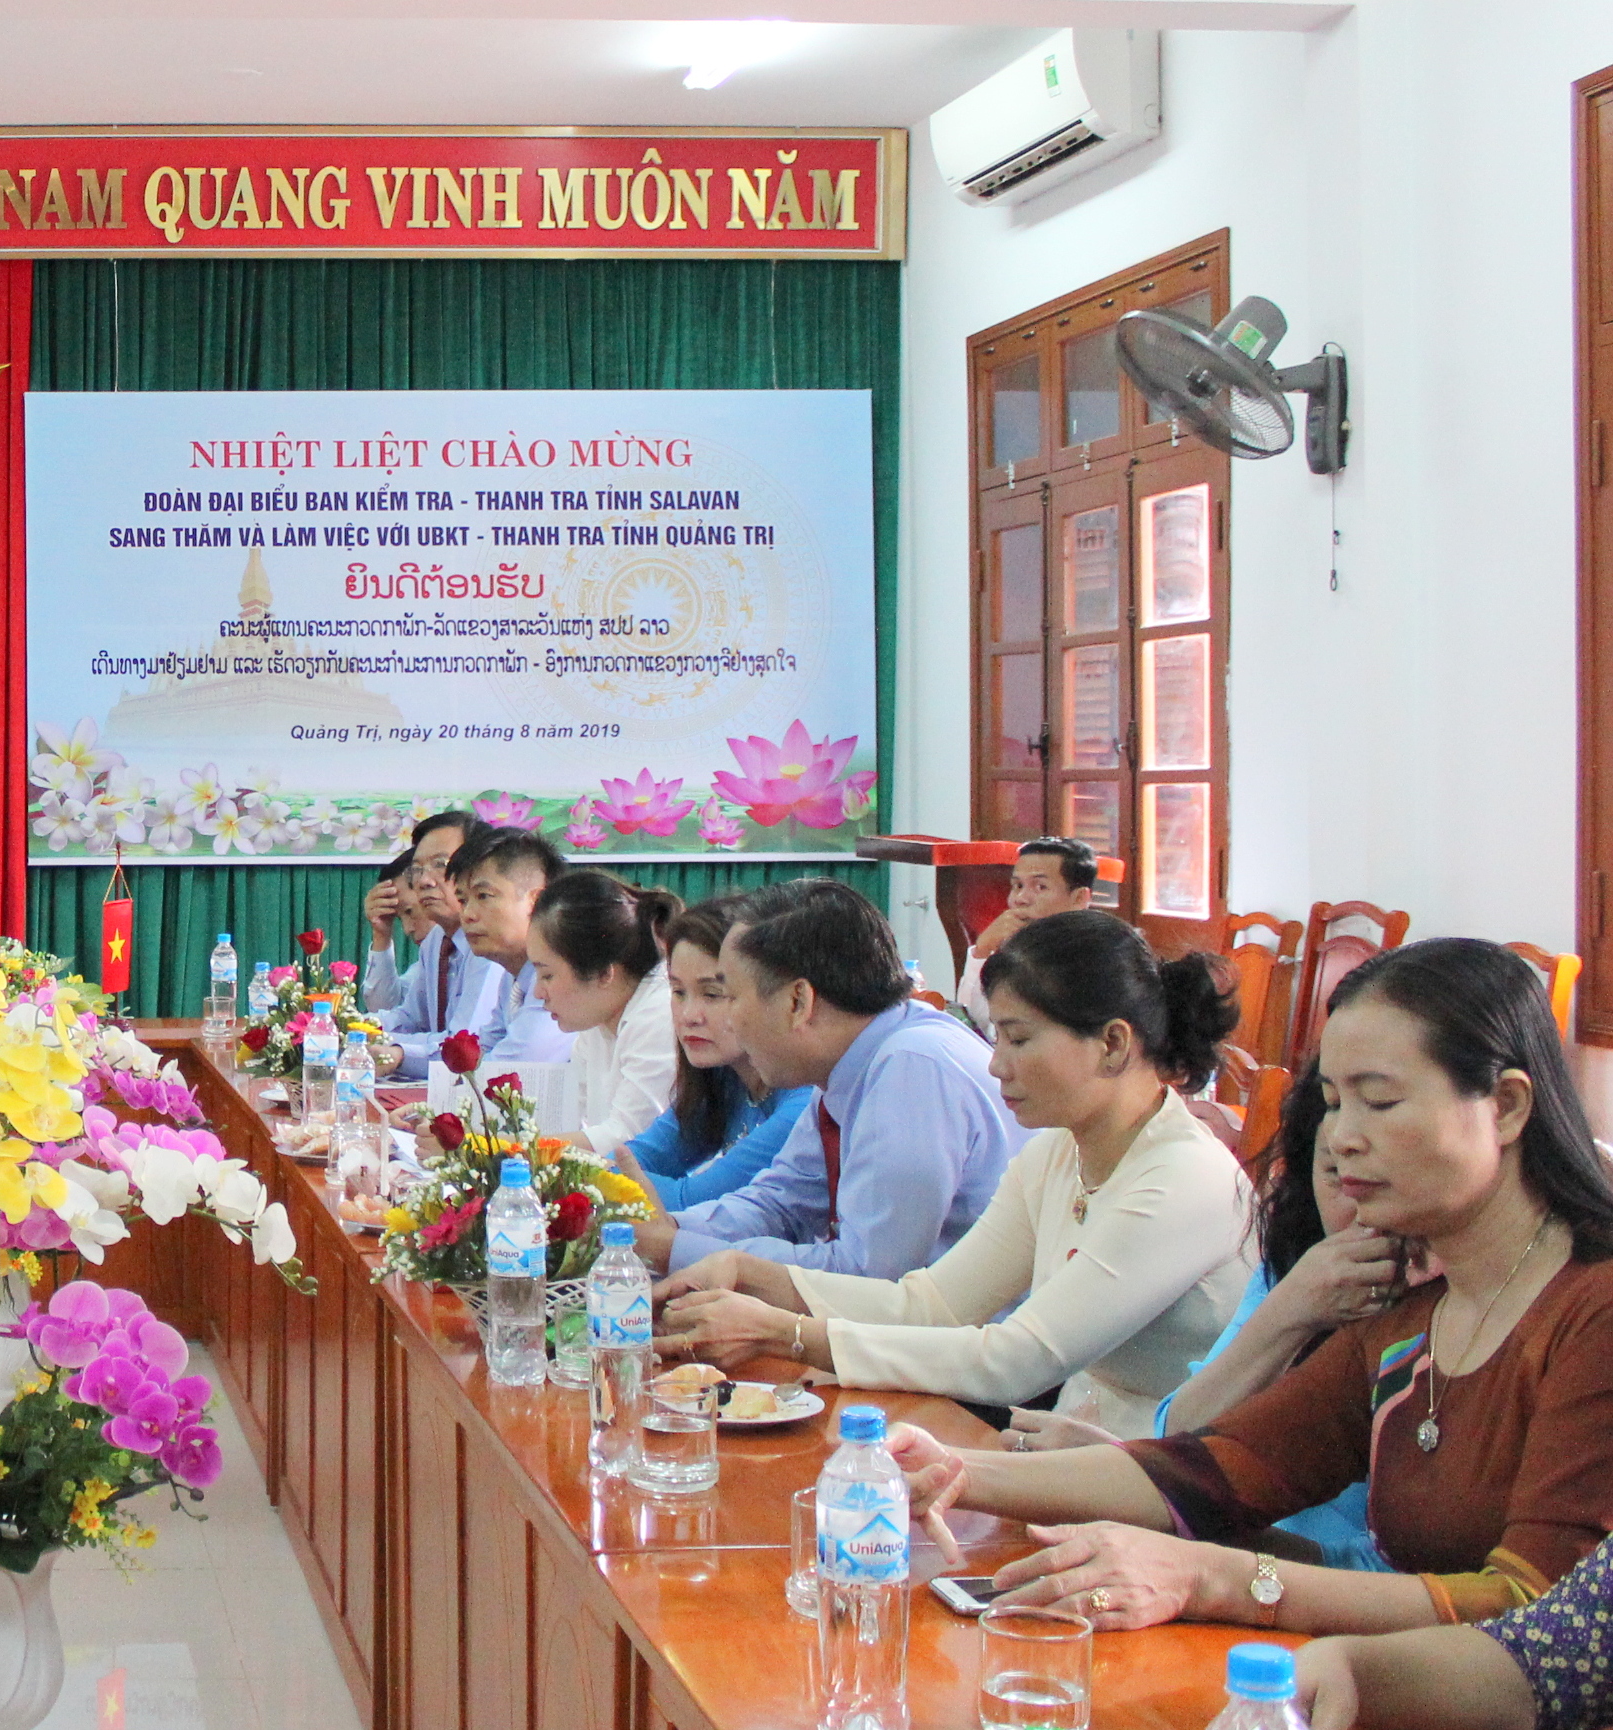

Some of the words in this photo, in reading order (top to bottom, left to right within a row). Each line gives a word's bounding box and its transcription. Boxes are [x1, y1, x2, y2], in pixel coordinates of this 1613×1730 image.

[143, 165, 351, 243] QUANG
[365, 165, 523, 230] VINH
[537, 148, 714, 231] MUÔN
[725, 149, 861, 231] NĂM
[189, 431, 321, 476] NHIỆT
[333, 430, 428, 476] LIỆT
[441, 430, 556, 468] CHÀO
[569, 429, 693, 468] MỪNG
[144, 487, 202, 512] ĐOÀN
[208, 491, 243, 517] ĐẠI
[250, 483, 298, 511] BIỂU
[305, 491, 348, 511] BAN
[355, 483, 408, 511] KIỂM
[415, 491, 454, 511] TRA
[475, 490, 543, 511] THANH
[550, 490, 589, 511] TRA
[595, 484, 642, 511] TỈNH
[649, 490, 740, 511] SALAVAN
[109, 527, 166, 548] SANG
[172, 523, 232, 548] THĂM
[238, 522, 266, 547] VÀ
[272, 522, 317, 547] LÀM
[323, 522, 370, 551] VIỆC
[376, 522, 410, 547] VỚI
[417, 526, 470, 547] UBKT
[491, 526, 560, 546] THANH
[566, 526, 605, 546] TRA
[611, 519, 658, 546] TỈNH
[666, 519, 736, 547] QUẢNG
[742, 525, 774, 550] TRỊ
[345, 562, 545, 600] ຍິນດີຕ້ອນຮັບ
[599, 614, 634, 636] ສປປ
[639, 618, 670, 636] ລາວ
[233, 656, 263, 675] ແລະ
[290, 724, 350, 742] Quảng
[355, 724, 382, 742] Trị,
[388, 726, 433, 742] ngày
[438, 724, 459, 739] 20
[464, 723, 515, 742] tháng
[520, 723, 531, 738] 8
[535, 724, 573, 738] năm
[579, 723, 621, 738] 2019
[849, 1541, 904, 1557] UniAqua
